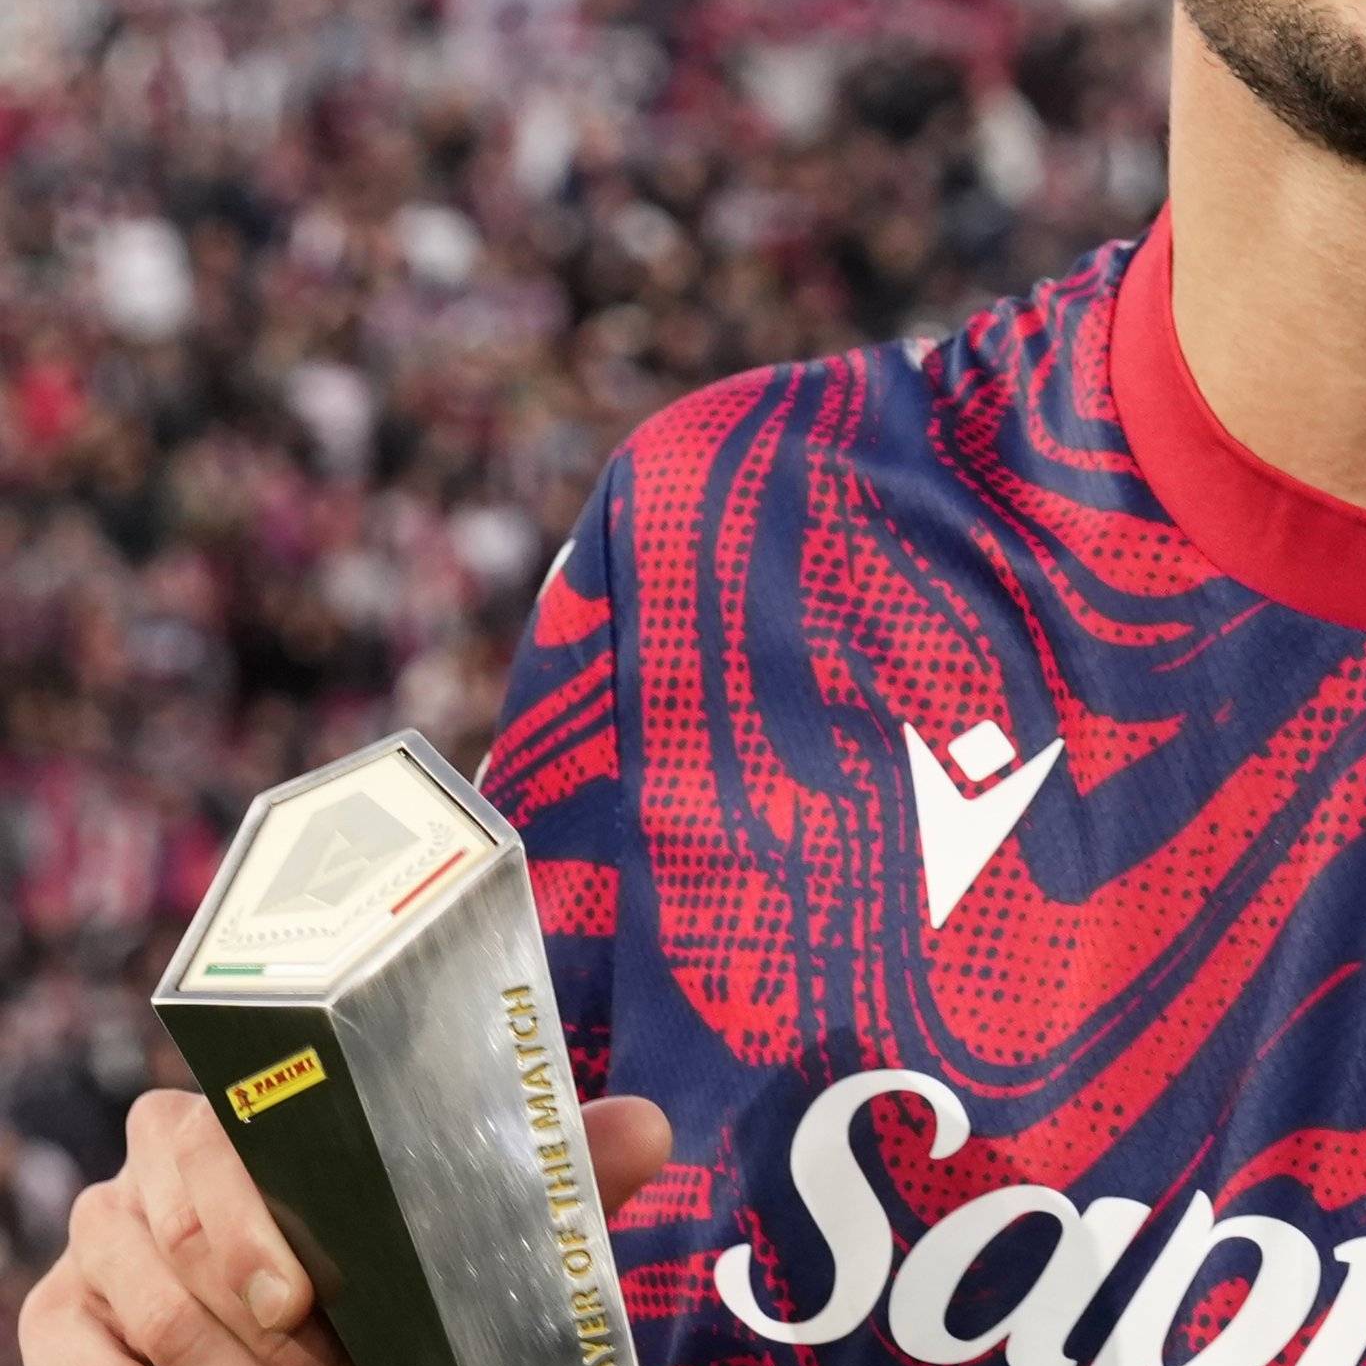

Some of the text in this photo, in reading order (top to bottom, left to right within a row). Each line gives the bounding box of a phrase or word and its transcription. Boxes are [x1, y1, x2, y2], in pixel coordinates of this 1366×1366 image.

[253, 1057, 315, 1095] PANINI
[501, 984, 561, 1133] MATCH
[537, 1140, 583, 1220] THE
[556, 1227, 593, 1280] OF
